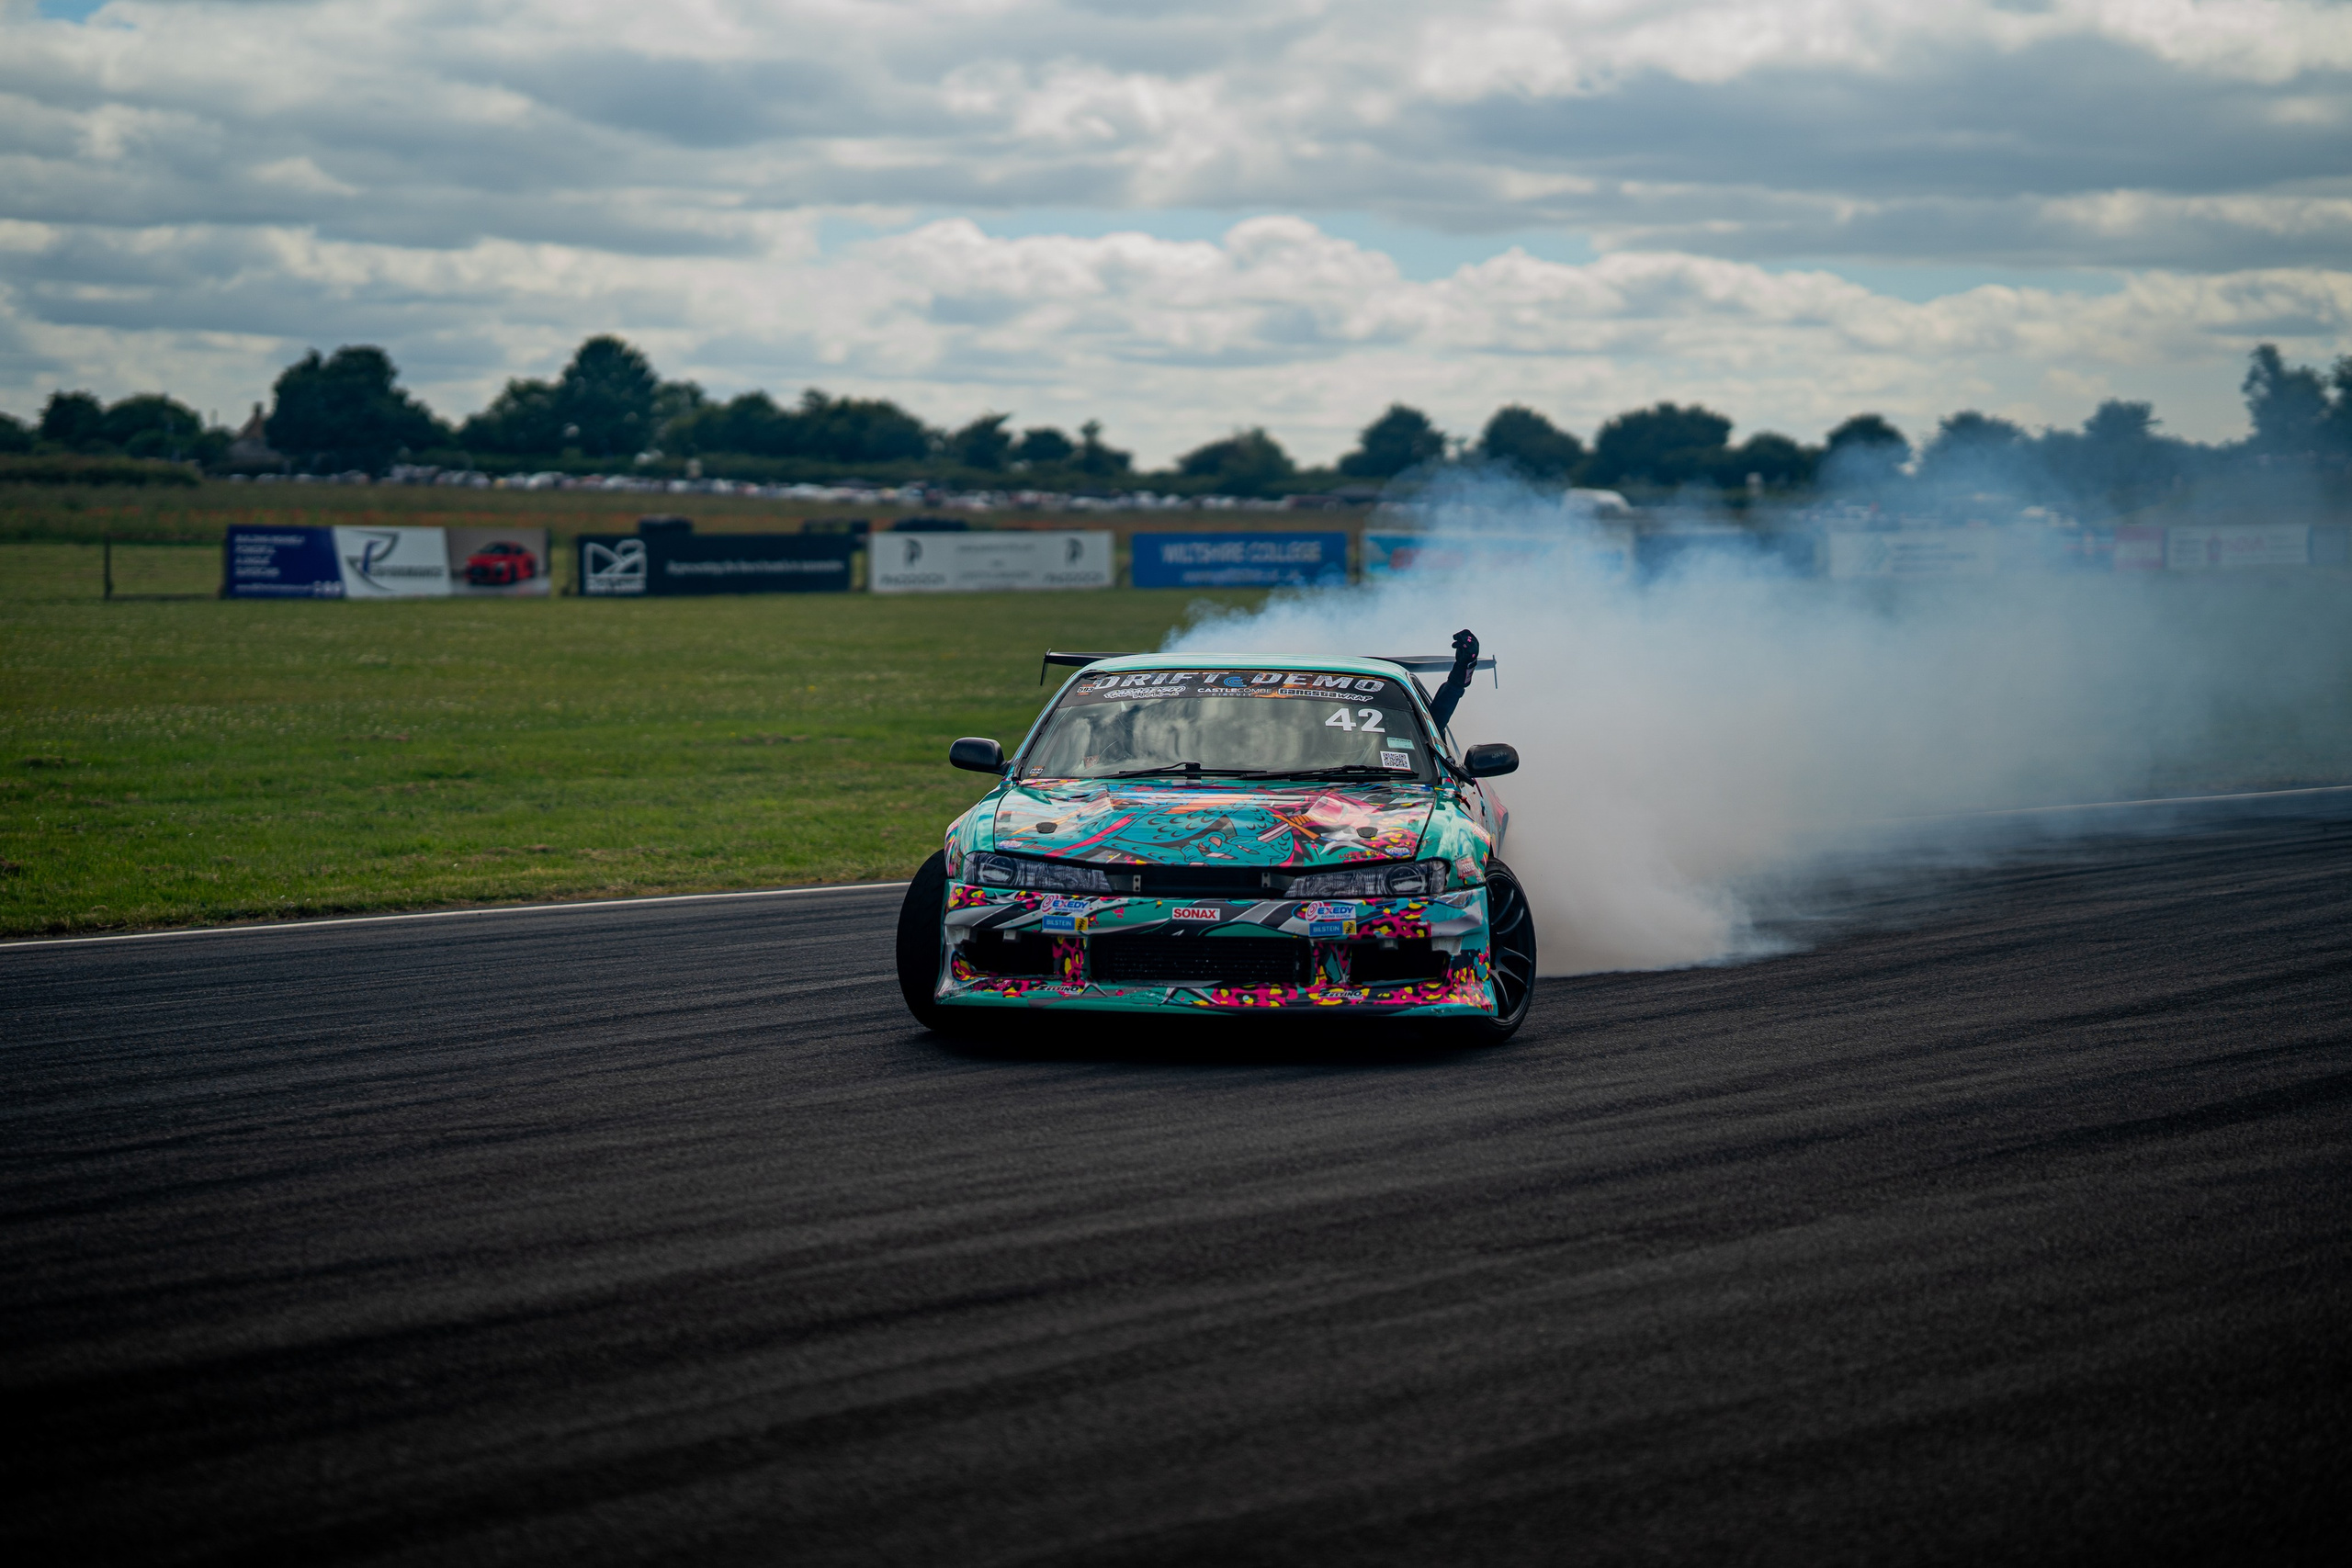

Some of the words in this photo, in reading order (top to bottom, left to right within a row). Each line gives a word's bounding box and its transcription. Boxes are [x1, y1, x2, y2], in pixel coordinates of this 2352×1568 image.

[1093, 672, 1229, 689] DRIFT
[1251, 672, 1385, 692] DEMO
[1325, 707, 1385, 733] 42
[1052, 899, 1088, 908] EXEDY
[1173, 908, 1216, 919] SONAX
[1317, 906, 1354, 914] EXEDY
[1046, 919, 1072, 927] BILSTEIN
[1313, 924, 1340, 932] BILSTEIN
